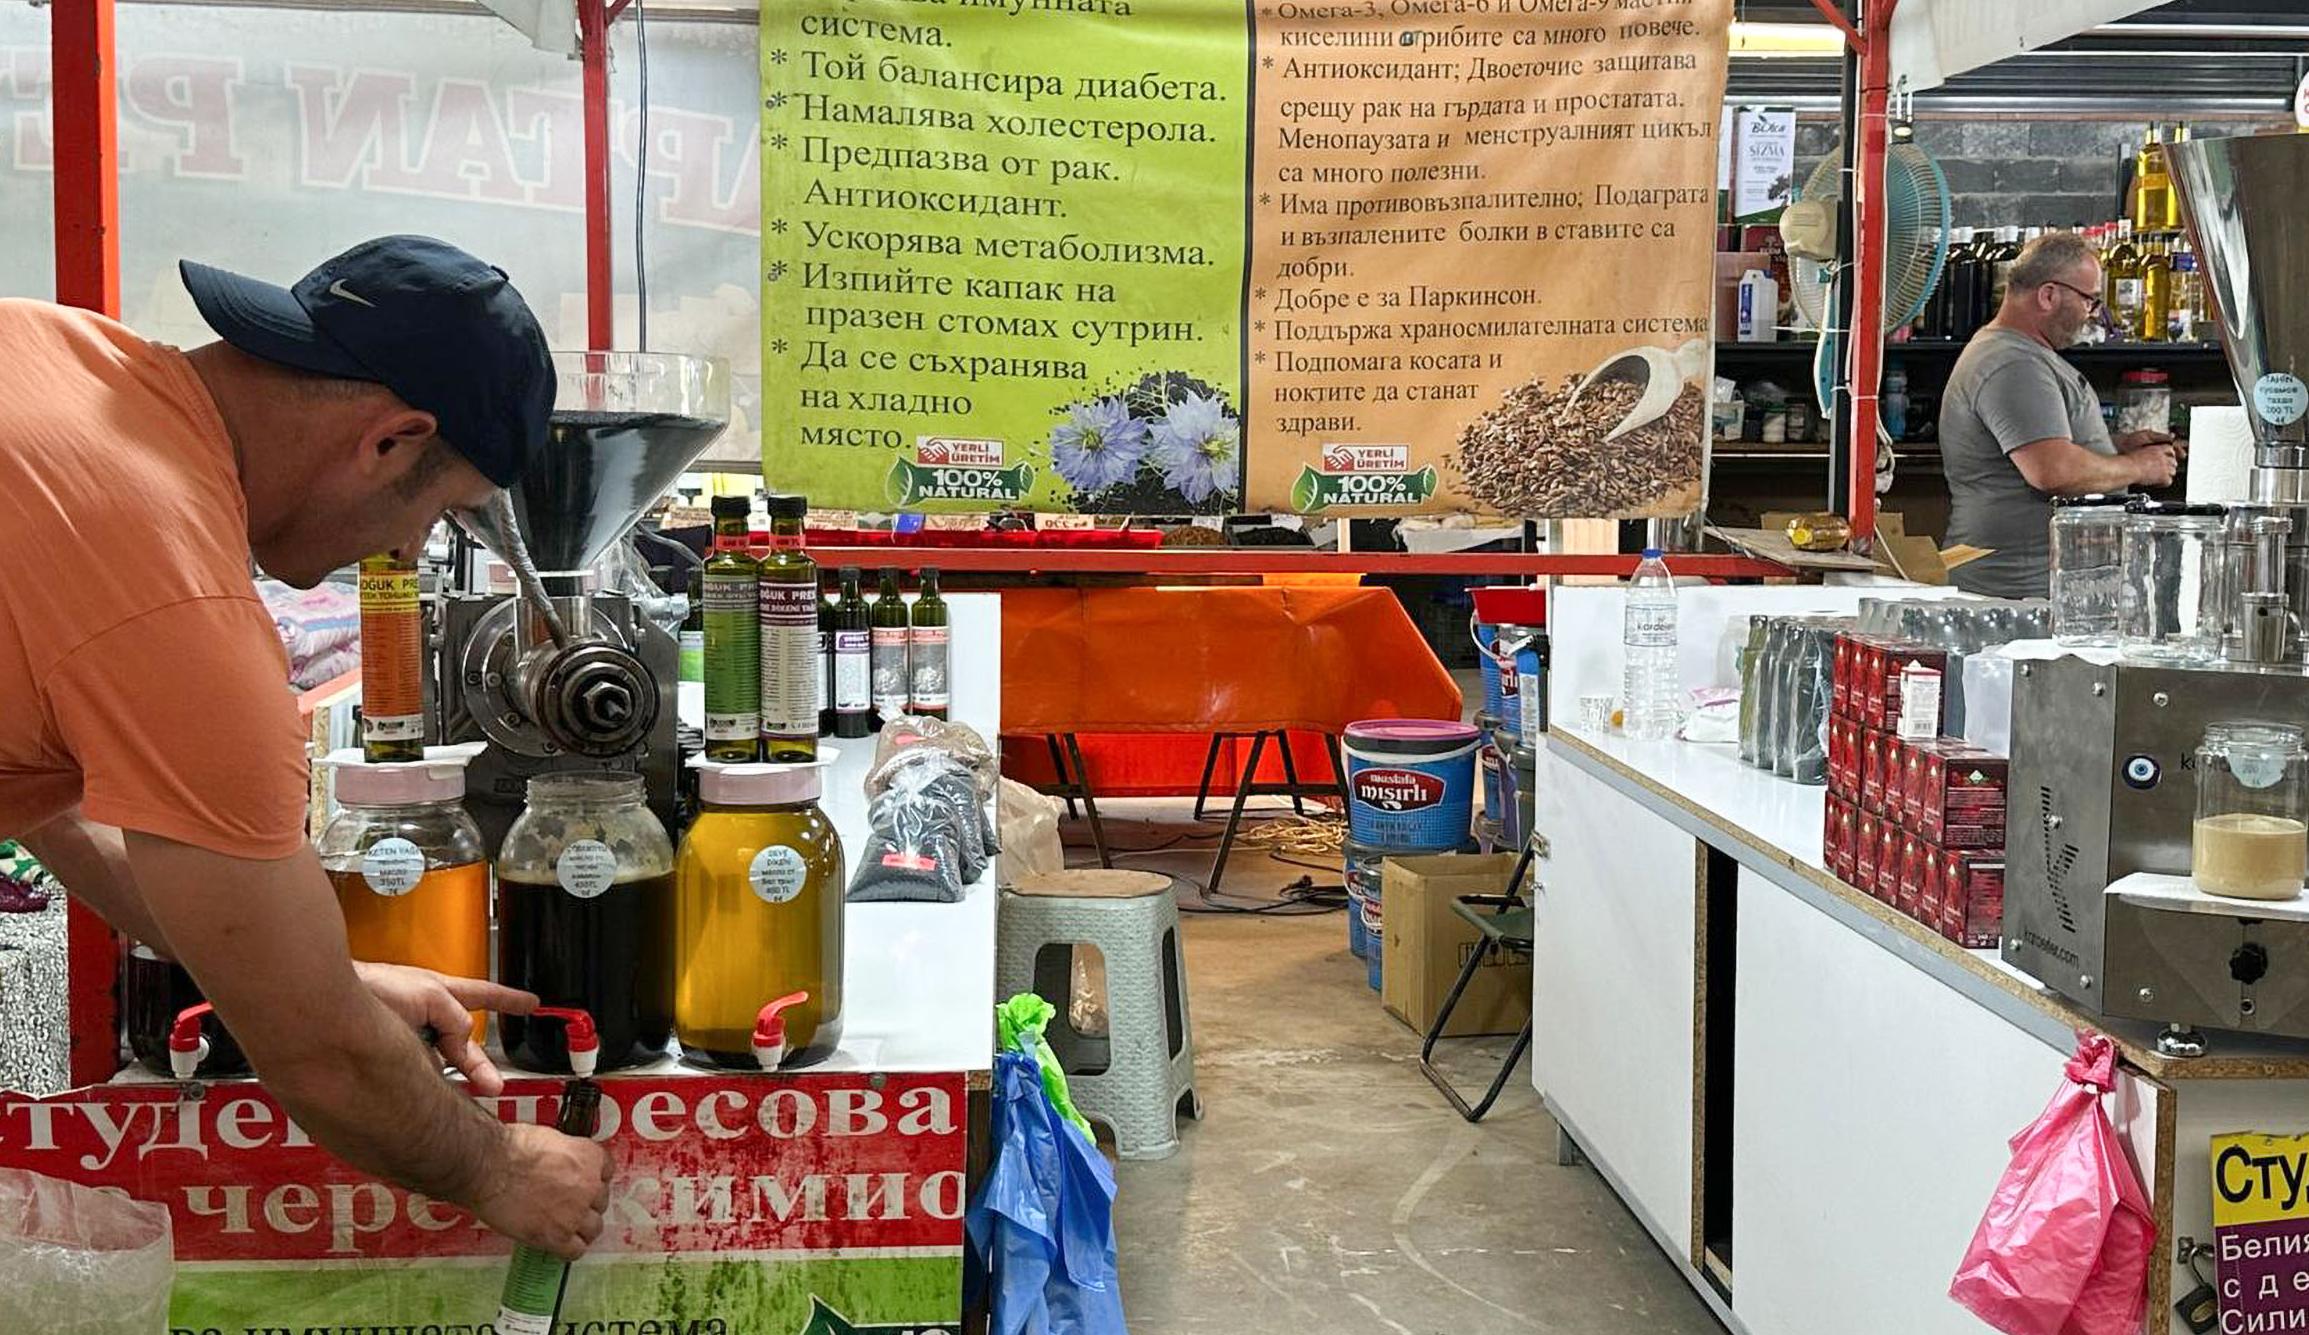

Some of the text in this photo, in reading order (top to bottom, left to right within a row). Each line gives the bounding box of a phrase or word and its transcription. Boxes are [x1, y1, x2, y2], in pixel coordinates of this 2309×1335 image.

[800, 14, 952, 48] система.
[1280, 31, 1393, 47] киселини
[1513, 31, 1536, 46] са
[1543, 26, 1606, 45] много
[1619, 20, 1700, 40] повече.
[800, 50, 1227, 103] Той балансира диабета.
[1281, 54, 1697, 84] Антиоксидант; Двоеточие защитава
[802, 94, 1216, 148] Намалява холестерола.
[1280, 91, 1685, 125] срещу рак на гърдата и простатата.
[1278, 121, 1713, 156] Менопаузата и менструалният цикъл
[801, 135, 1120, 187] Предпазва от рак.
[1278, 164, 1486, 184] са много полезни.
[802, 177, 1067, 219] Антиоксидант.
[1280, 183, 1709, 222] Има противовъзпалително; Подаграта
[801, 220, 1214, 267] Ускорява метаболизма.
[1280, 219, 1676, 247] и възпалените болки в ставите са
[801, 261, 1117, 303] Изпийте капак на
[1275, 255, 1355, 284] добри.
[1273, 285, 1542, 316] Добре е за Паркинсон.
[805, 306, 1203, 348] празен стомах сутрин.
[1274, 316, 1710, 347] Поддържа храносмилателната система
[800, 340, 1090, 383] Да се съхранява
[1274, 350, 1503, 376] Подпомага косата и
[799, 389, 973, 417] на хладно
[1274, 383, 1480, 405] ноктите да станат
[800, 426, 912, 450] място.
[1275, 415, 1362, 438] здрави.
[918, 485, 1016, 500] NATURAL
[933, 470, 1002, 488] 100%
[1337, 475, 1406, 493] 100%
[1323, 492, 1420, 504] NATURAL
[1370, 773, 1416, 785] mustafa
[180, 1180, 495, 1254] чере
